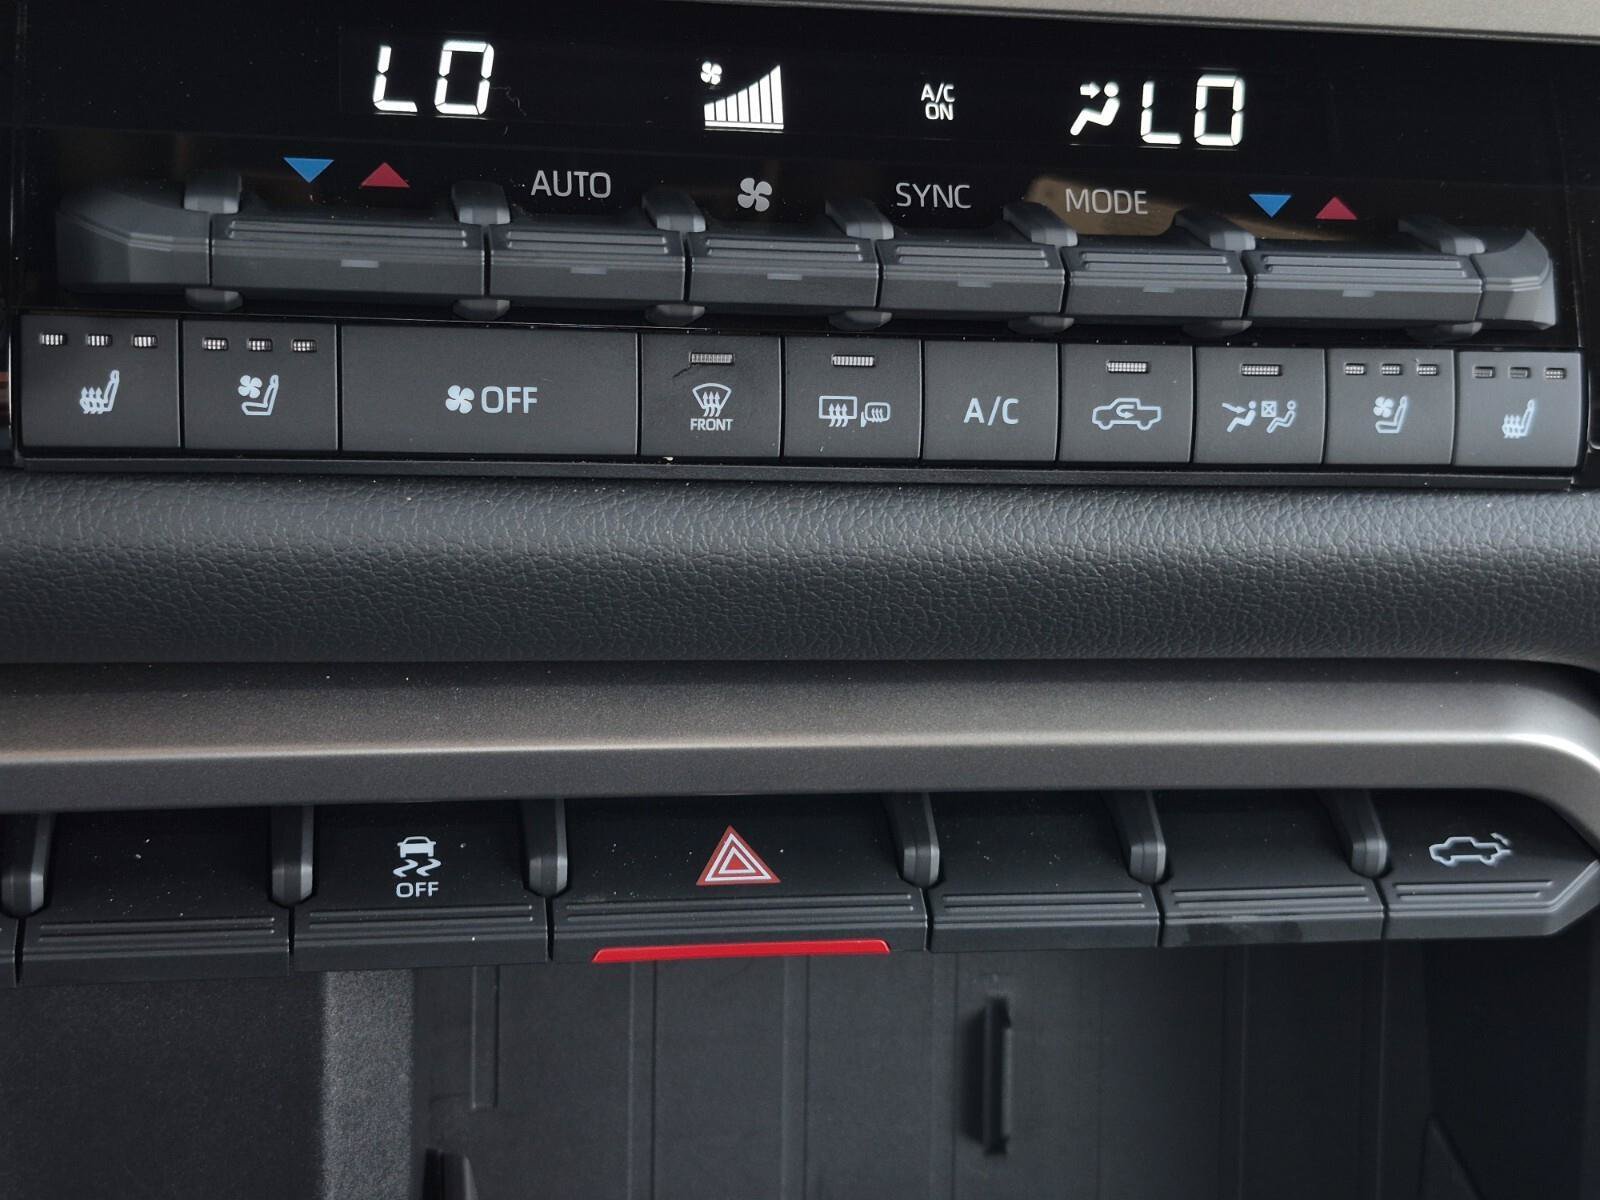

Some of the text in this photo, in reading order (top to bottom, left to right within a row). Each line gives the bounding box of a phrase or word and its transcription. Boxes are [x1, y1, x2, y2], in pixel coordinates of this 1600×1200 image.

[920, 83, 955, 103] A/C
[925, 102, 954, 121] ON
[530, 170, 612, 199] AUTO
[895, 182, 971, 210] SYNC
[1065, 188, 1148, 215] MODE
[481, 385, 538, 414] OFF
[963, 397, 1020, 426] A/C
[690, 418, 733, 431] FRONT
[395, 881, 439, 898] OFF
